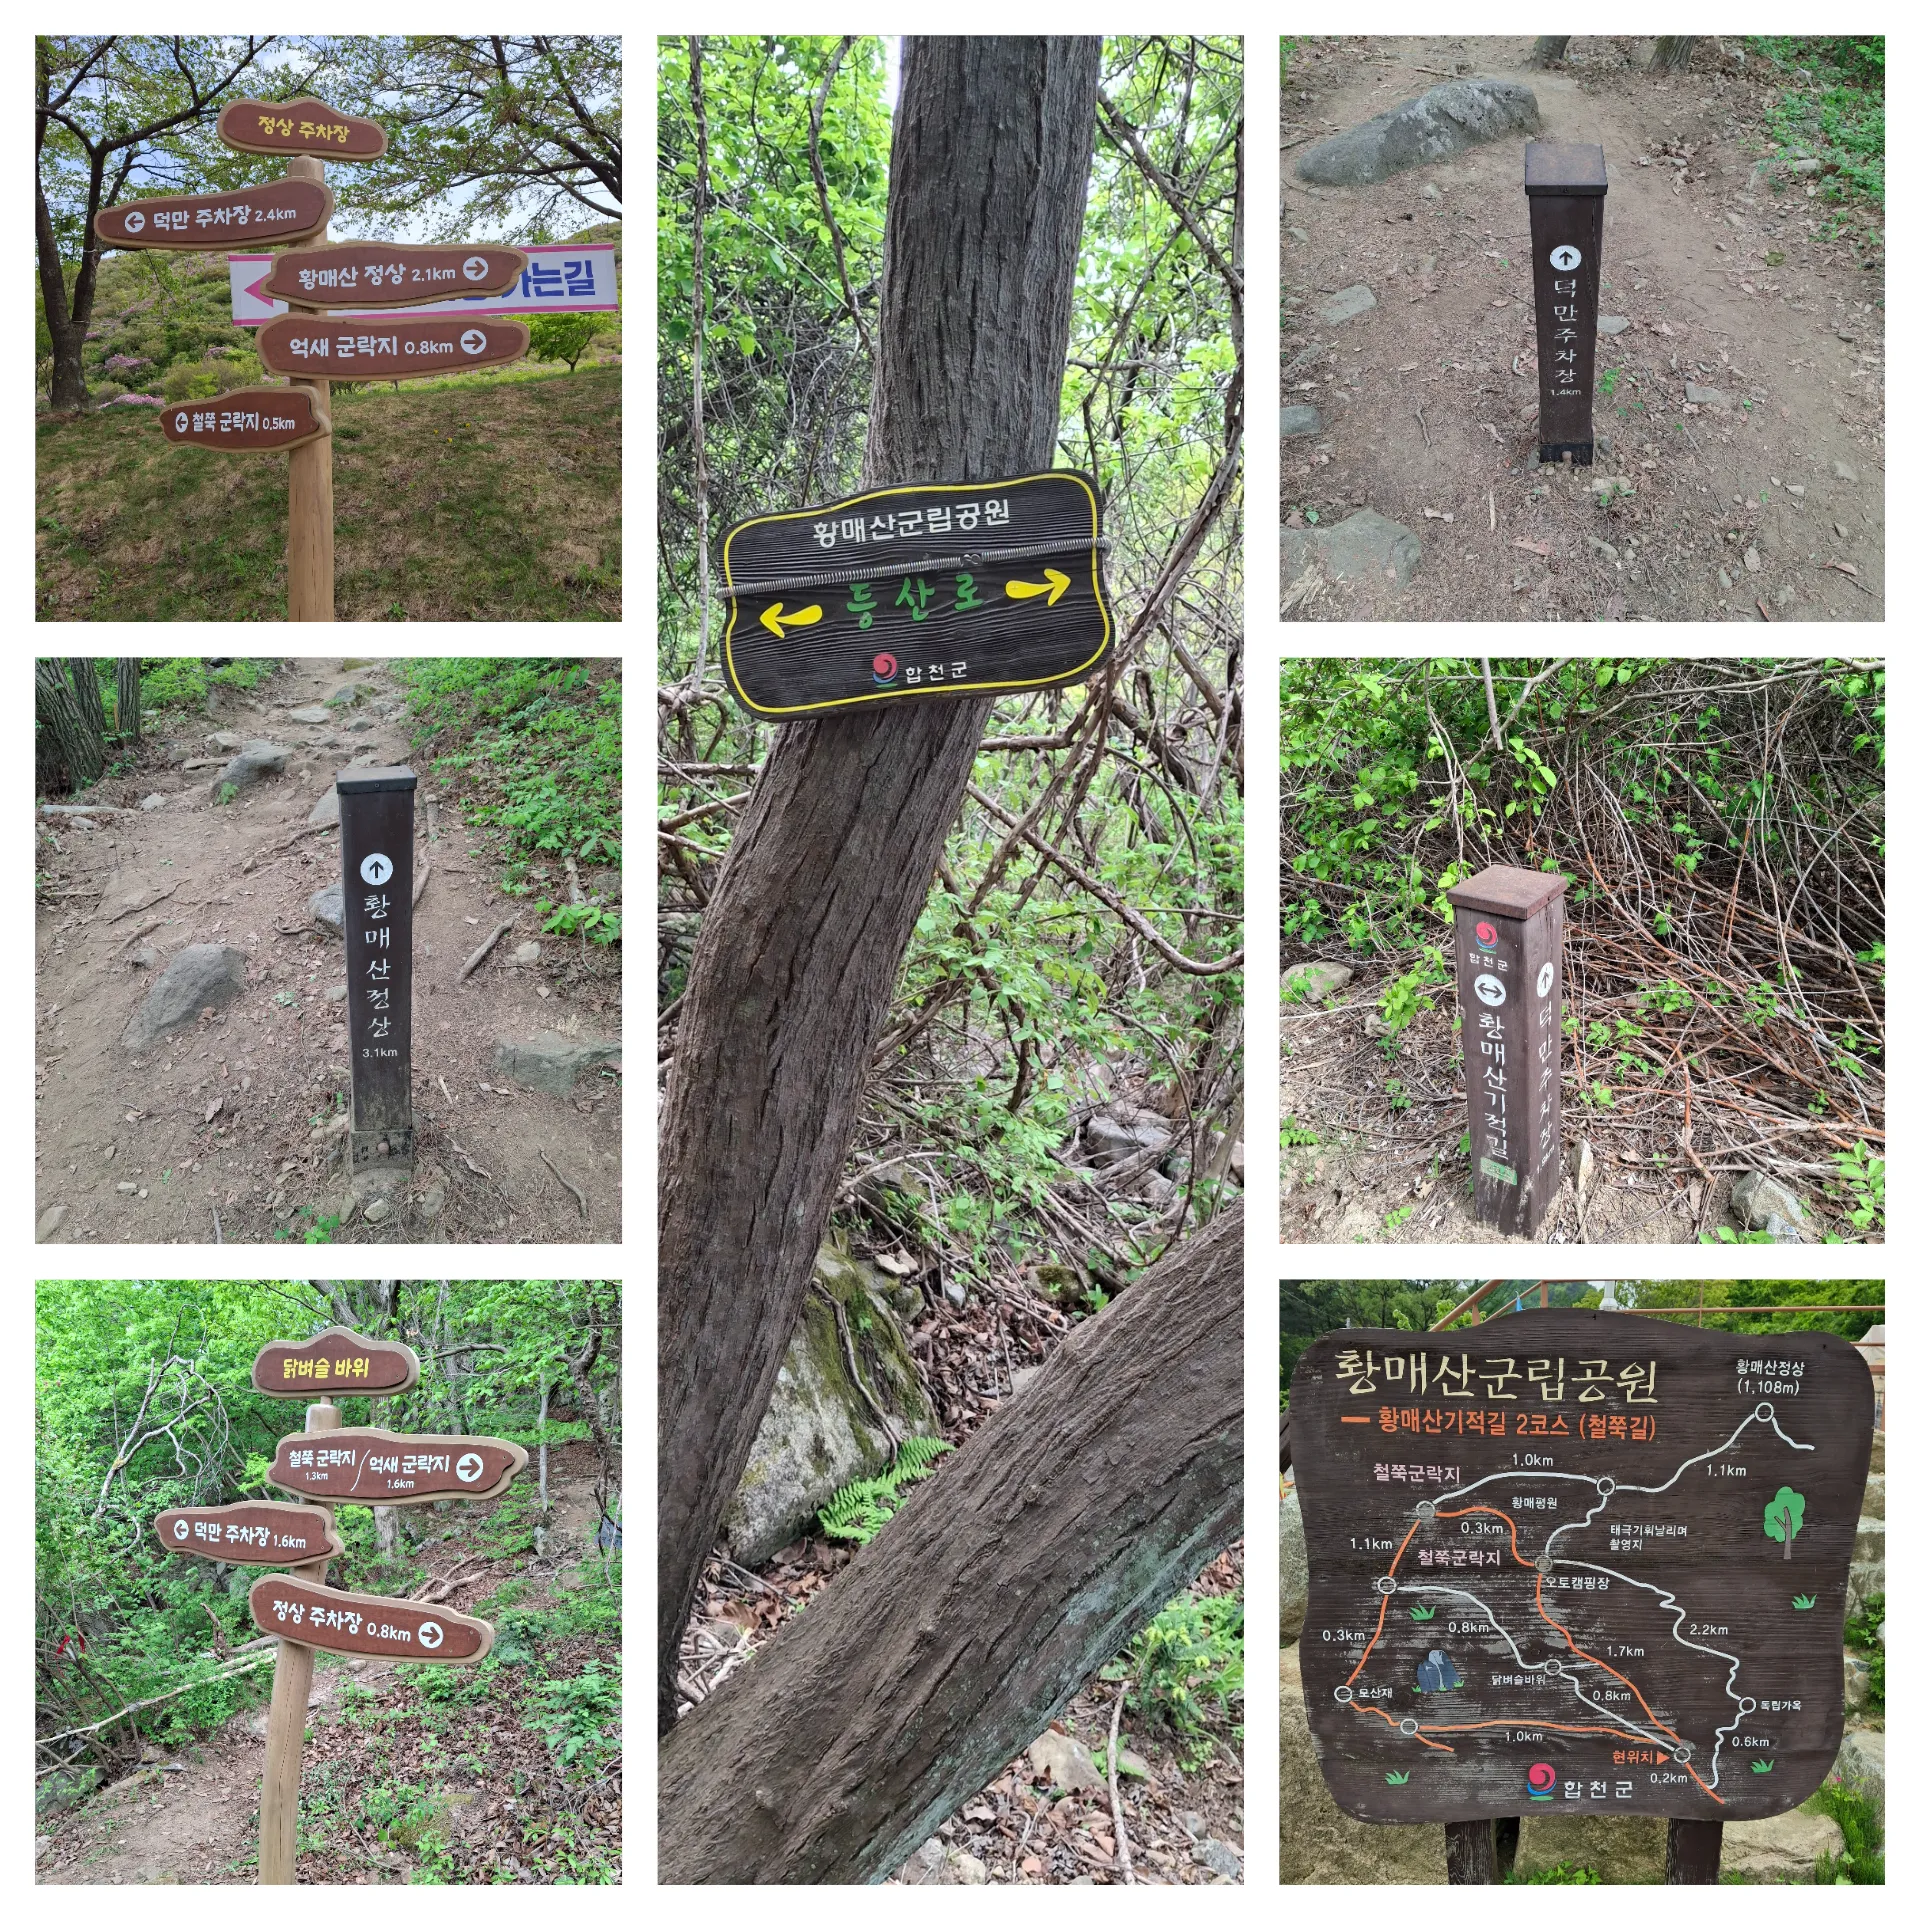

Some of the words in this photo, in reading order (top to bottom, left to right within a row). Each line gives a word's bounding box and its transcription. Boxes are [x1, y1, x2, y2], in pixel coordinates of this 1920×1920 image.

[257, 115, 294, 138] 정상
[298, 119, 350, 143] 주차장
[153, 208, 189, 231] 덕만
[195, 204, 251, 227] 주차장
[254, 206, 297, 222] 2.4km
[297, 266, 359, 290] 황매산
[364, 263, 407, 287] 정상
[411, 265, 456, 283] 2.1km
[290, 336, 329, 359] 억새
[336, 334, 397, 358] 군락지
[404, 338, 454, 356] 0.8km
[1550, 388, 1582, 397] 1.4km
[192, 412, 216, 432] 철쭉
[220, 411, 259, 431] 군락지
[262, 415, 296, 430] 0.5km
[813, 500, 1009, 547] 황매산군립공원
[362, 1048, 398, 1058] 3.1km
[283, 1358, 331, 1379] 닭벼슬
[334, 1358, 369, 1378] 바위
[1334, 1348, 1658, 1404] 황매산군립공원
[1736, 1358, 1805, 1378] 황매산정상
[1737, 1378, 1801, 1397] (1,108m)
[1378, 1406, 1507, 1436] 황매산기적길
[1516, 1412, 1569, 1437] 2코스
[1579, 1413, 1657, 1442] (철쭉길)
[289, 1450, 313, 1468] 철쭉
[316, 1449, 356, 1467] 군락지
[369, 1457, 398, 1475] 억새
[401, 1455, 450, 1475] 군락지
[1512, 1452, 1554, 1468] 1.0km
[305, 1471, 329, 1481] 1.3km
[1373, 1462, 1460, 1484] 철쭉군락지
[1706, 1463, 1747, 1478] 1.1km
[386, 1478, 414, 1490] 1.6km
[1511, 1496, 1558, 1510] 황매평원
[194, 1521, 222, 1539] 덕만
[225, 1524, 271, 1547] 주차장
[273, 1534, 306, 1549] 1.6km
[1460, 1521, 1504, 1535] 0.3km
[1610, 1524, 1688, 1538] 태극기휘날리며
[1349, 1536, 1393, 1551] 1.1km
[1609, 1537, 1644, 1551] 촬영지
[1417, 1548, 1501, 1568] 철쭉군락지
[1545, 1576, 1610, 1592] 오토캠핑장
[272, 1600, 305, 1625] 정상
[309, 1606, 363, 1635] 주차장
[367, 1621, 411, 1643] 0.8km
[1447, 1620, 1490, 1636] 0.8km
[1322, 1628, 1366, 1643] 0.3km
[1689, 1623, 1729, 1637] 2.2km
[1606, 1645, 1645, 1659] 1.7km
[1490, 1673, 1547, 1687] 닭벼슬바위
[1357, 1686, 1393, 1700] 모산재
[1592, 1689, 1631, 1703] 0.8km
[1760, 1699, 1802, 1712] 독립가옥
[1505, 1730, 1543, 1744] 1.0km
[1731, 1735, 1770, 1749] 0.6km
[1611, 1749, 1654, 1765] 현위치
[1649, 1771, 1688, 1785] 0.2km
